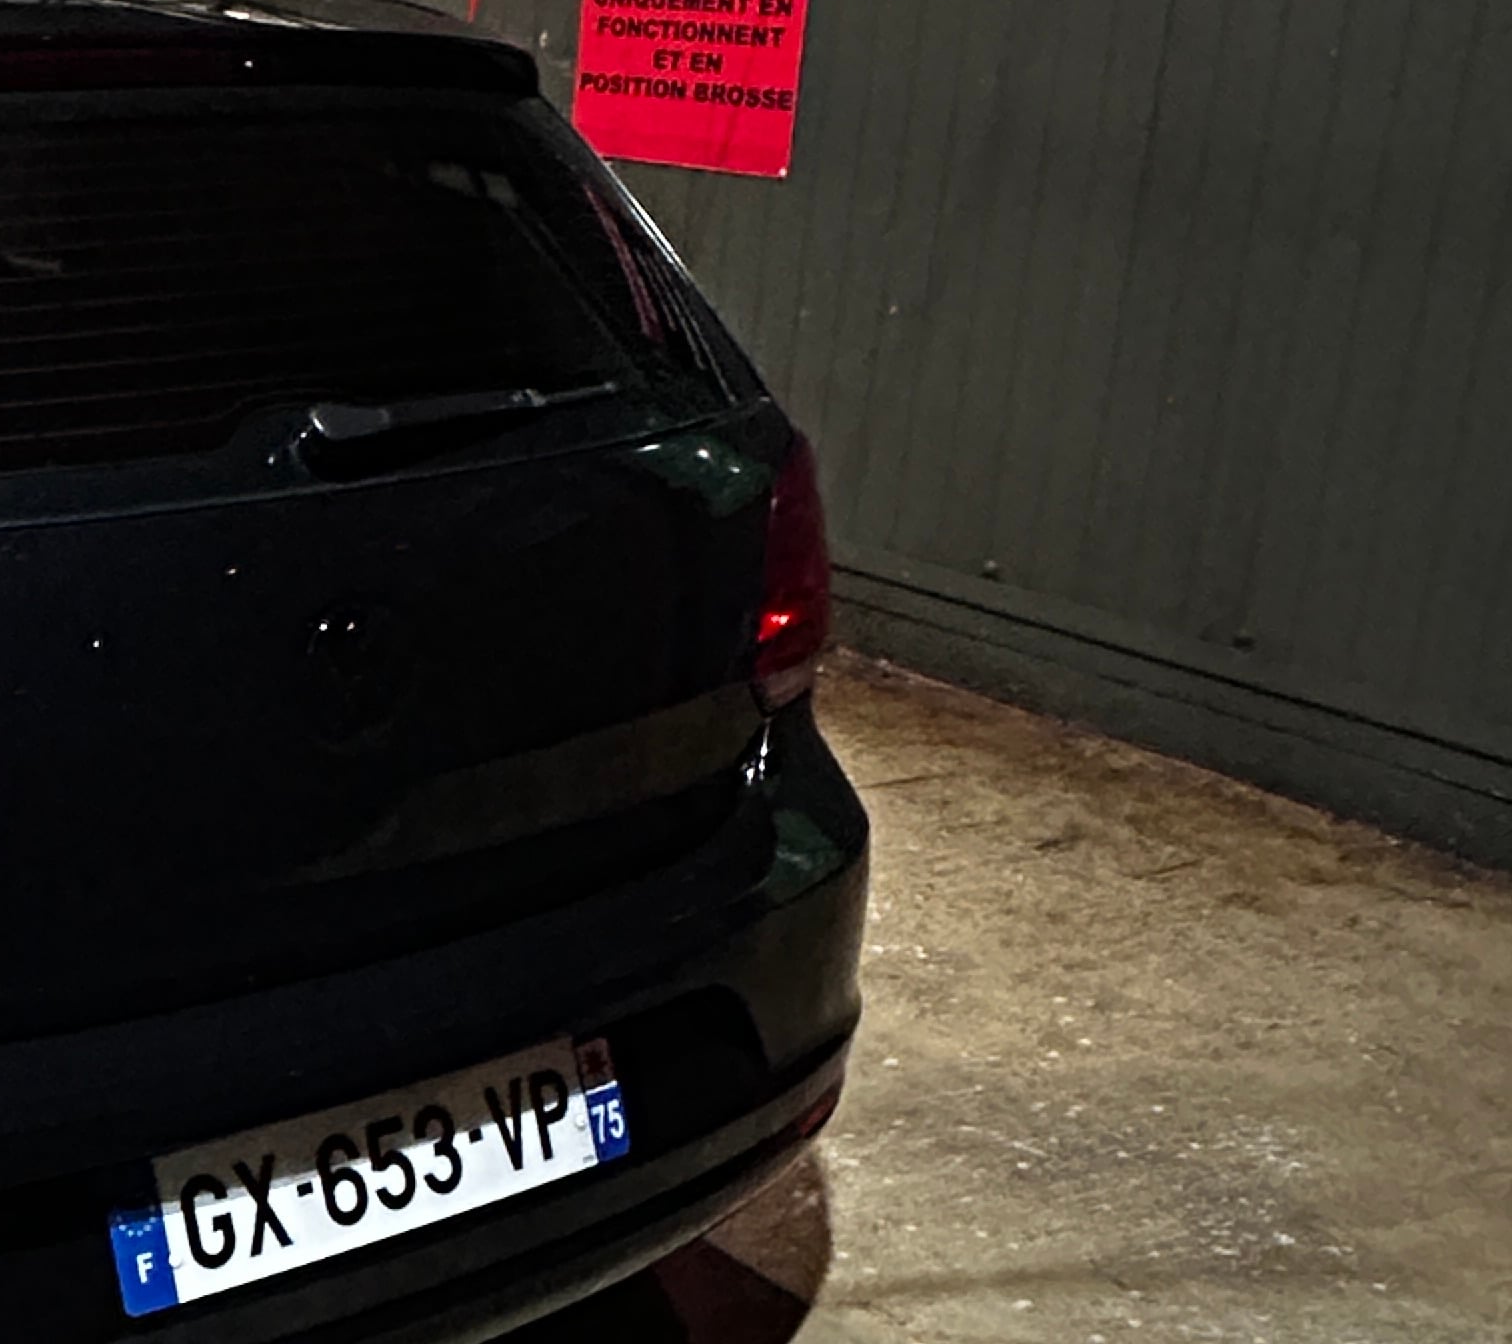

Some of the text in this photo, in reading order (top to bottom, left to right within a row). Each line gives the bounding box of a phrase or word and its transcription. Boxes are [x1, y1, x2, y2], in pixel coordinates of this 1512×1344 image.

[596, 15, 786, 49] FONCTIONNENT
[652, 49, 723, 74] ET EN
[579, 72, 794, 112] POSITION BROSSE
[136, 1068, 625, 1284] F GX-653-VP 75
